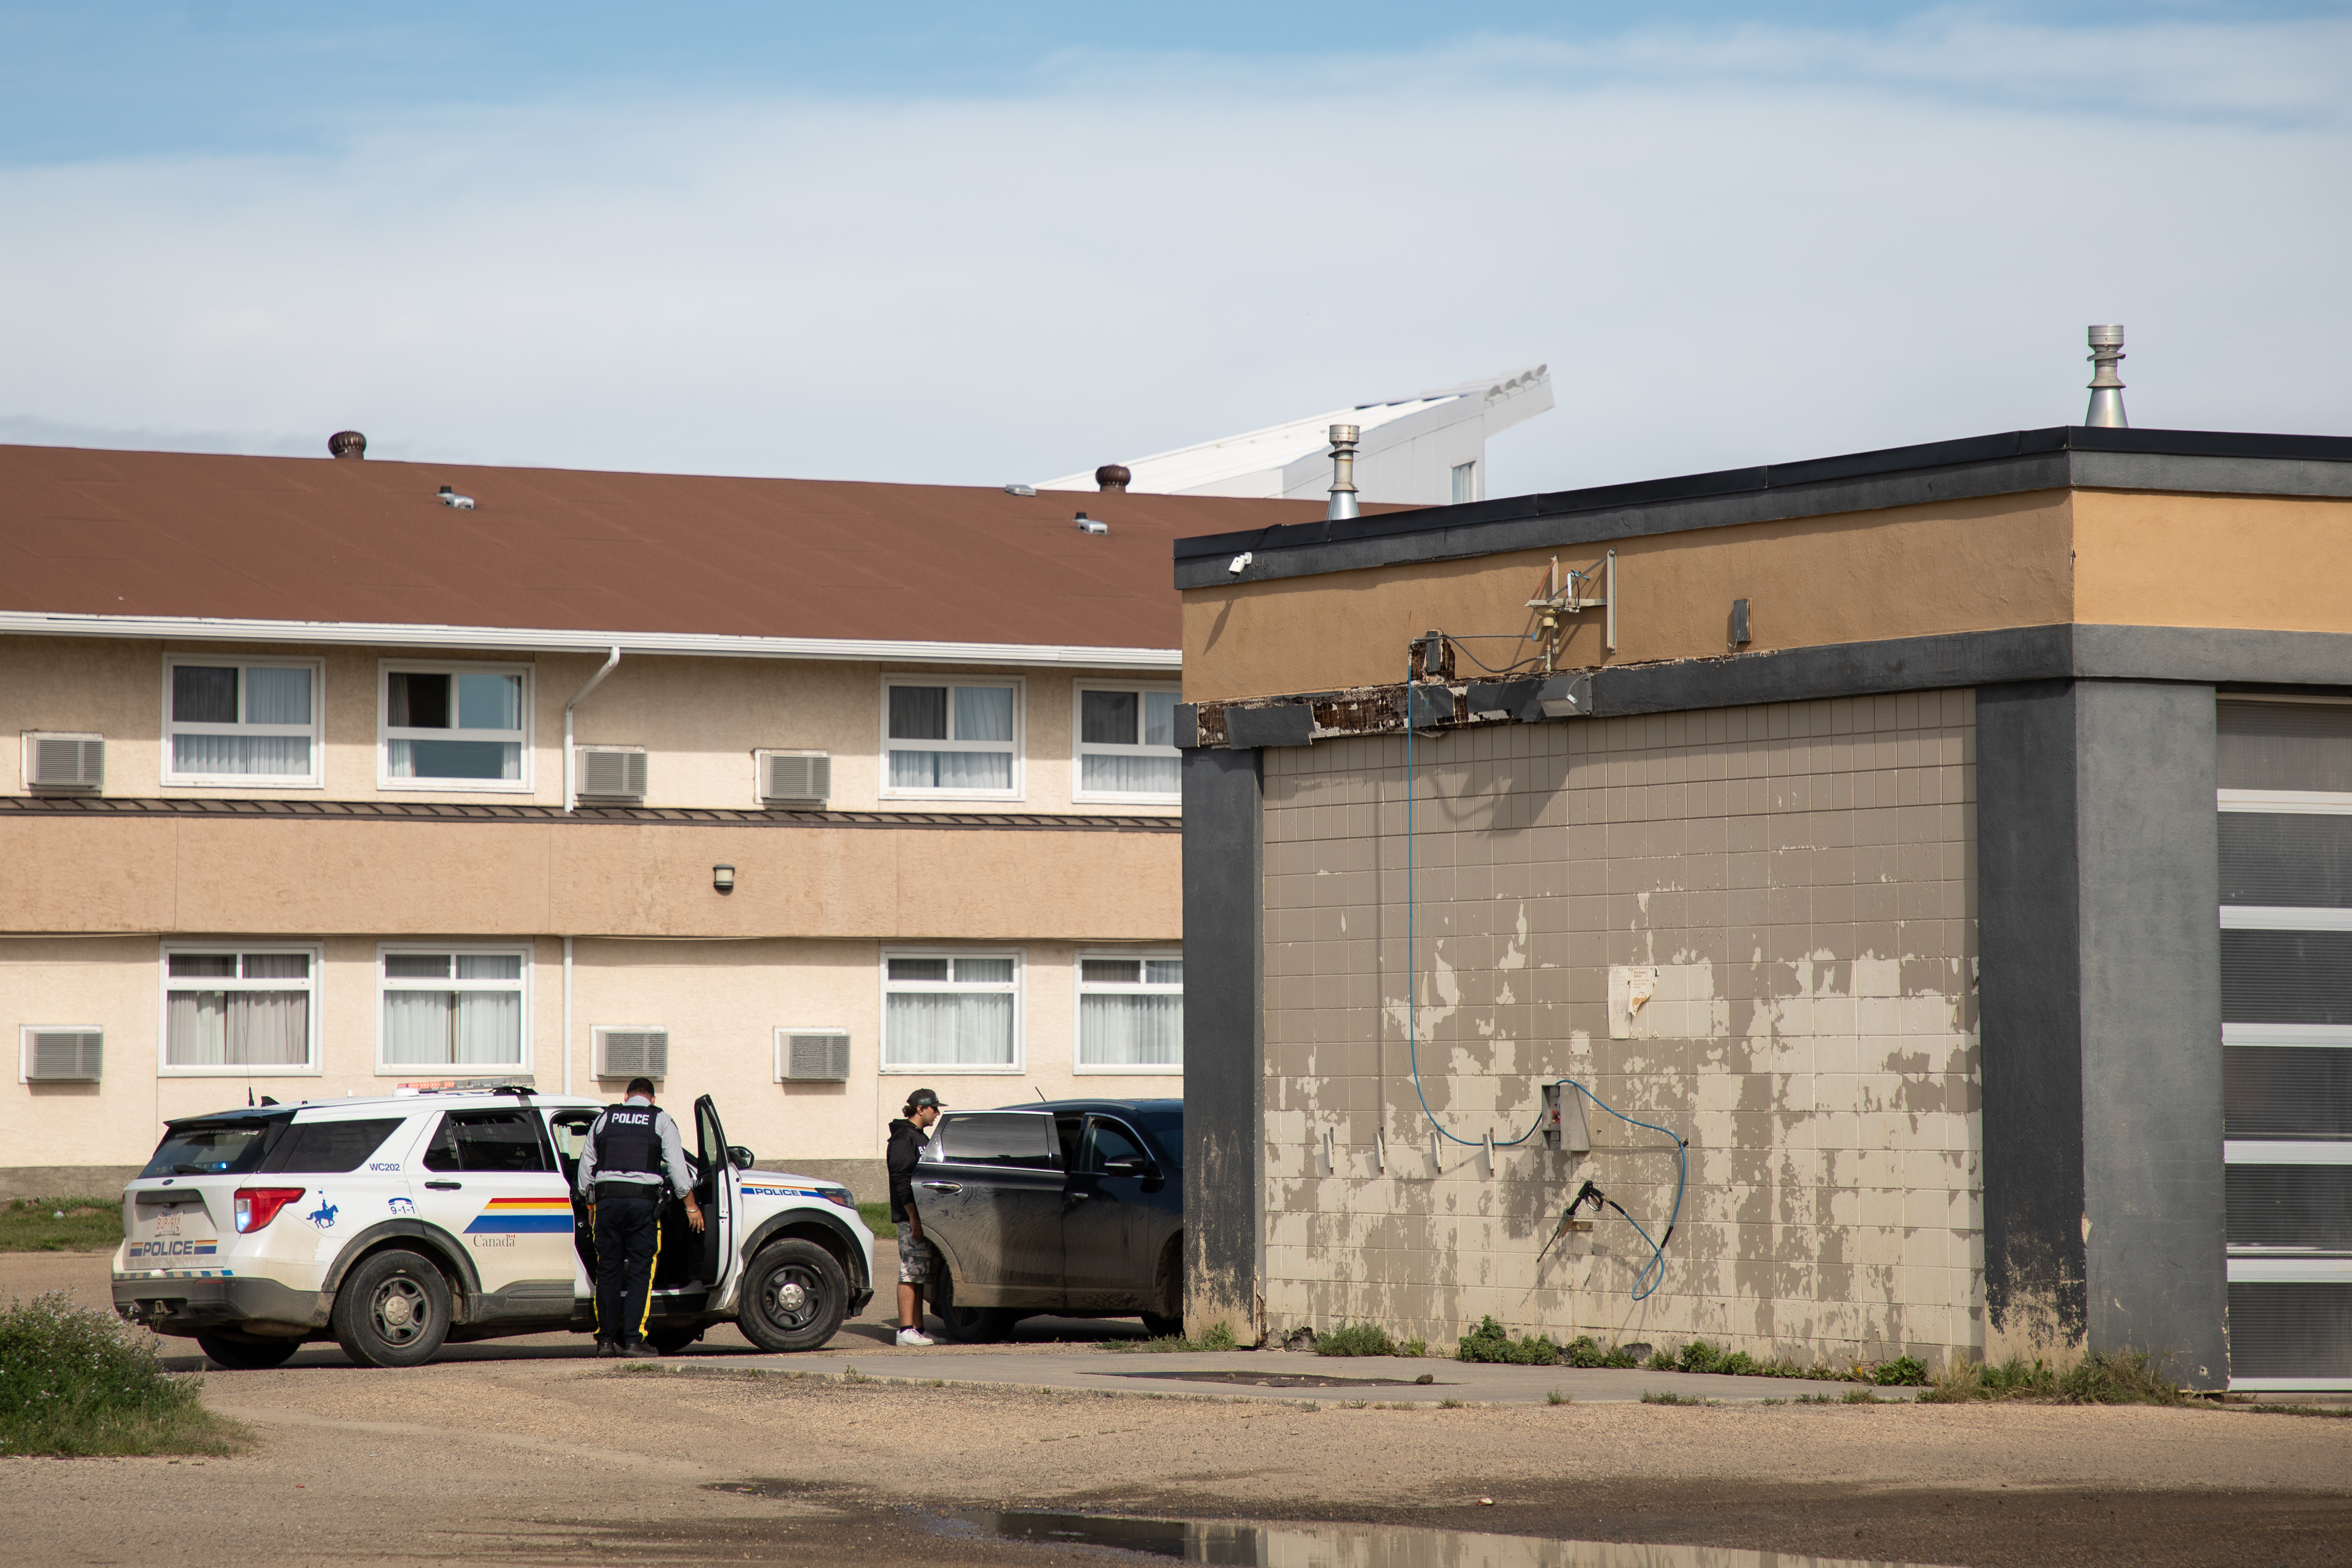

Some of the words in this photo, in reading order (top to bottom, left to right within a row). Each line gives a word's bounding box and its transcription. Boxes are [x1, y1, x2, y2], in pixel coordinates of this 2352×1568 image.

[611, 1113, 650, 1125] POLICE
[369, 1163, 400, 1171] WC202
[390, 1205, 415, 1214] 9-1-1
[473, 1234, 515, 1247] Canada
[143, 1241, 193, 1256] POLICE
